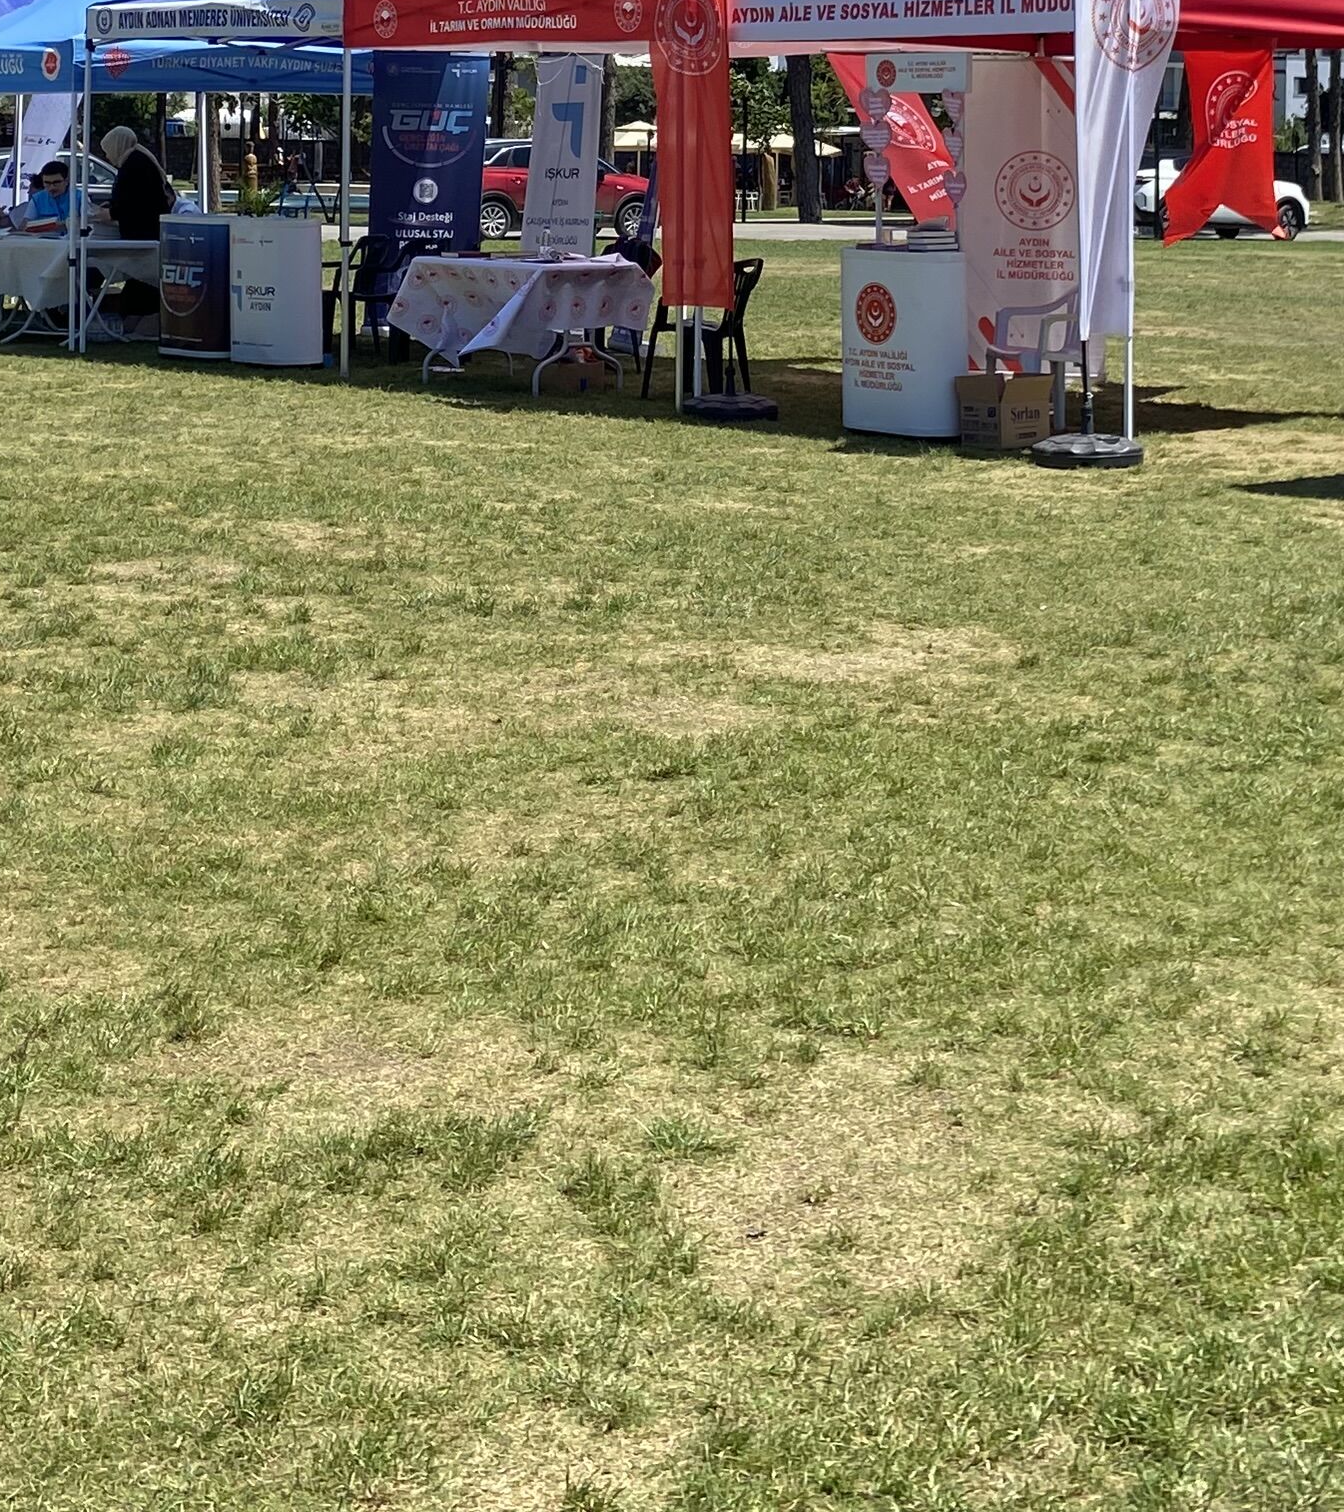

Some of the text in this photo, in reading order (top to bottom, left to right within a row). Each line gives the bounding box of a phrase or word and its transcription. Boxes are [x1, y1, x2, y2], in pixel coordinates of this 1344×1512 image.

[119, 11, 144, 29] AYDIN
[146, 9, 177, 28] ADNAN
[179, 8, 229, 28] MENDERES
[731, 6, 775, 24] AYDIN
[778, 2, 812, 23] AİLE
[816, 4, 837, 21] VE
[840, 1, 899, 20] SOSYAL
[439, 19, 465, 33] TARIM
[467, 18, 480, 31] VE
[480, 16, 514, 30] ORMAN
[515, 14, 577, 29] MÜDÜRLÜĞÜ
[199, 54, 246, 69] DİYANET
[248, 57, 278, 69] VAKFI
[280, 59, 312, 71] AYDIN
[313, 62, 343, 73] ŞUBE
[398, 211, 453, 224] Staj Desteği
[395, 229, 454, 238] ULUSAL STAJ
[1019, 238, 1050, 247] AYDIN
[993, 247, 1076, 259] AİLE VE SOSYAL
[1006, 258, 1064, 269] HİZMETLER
[996, 268, 1075, 281] İL MÜDÜRLÜĞÜ
